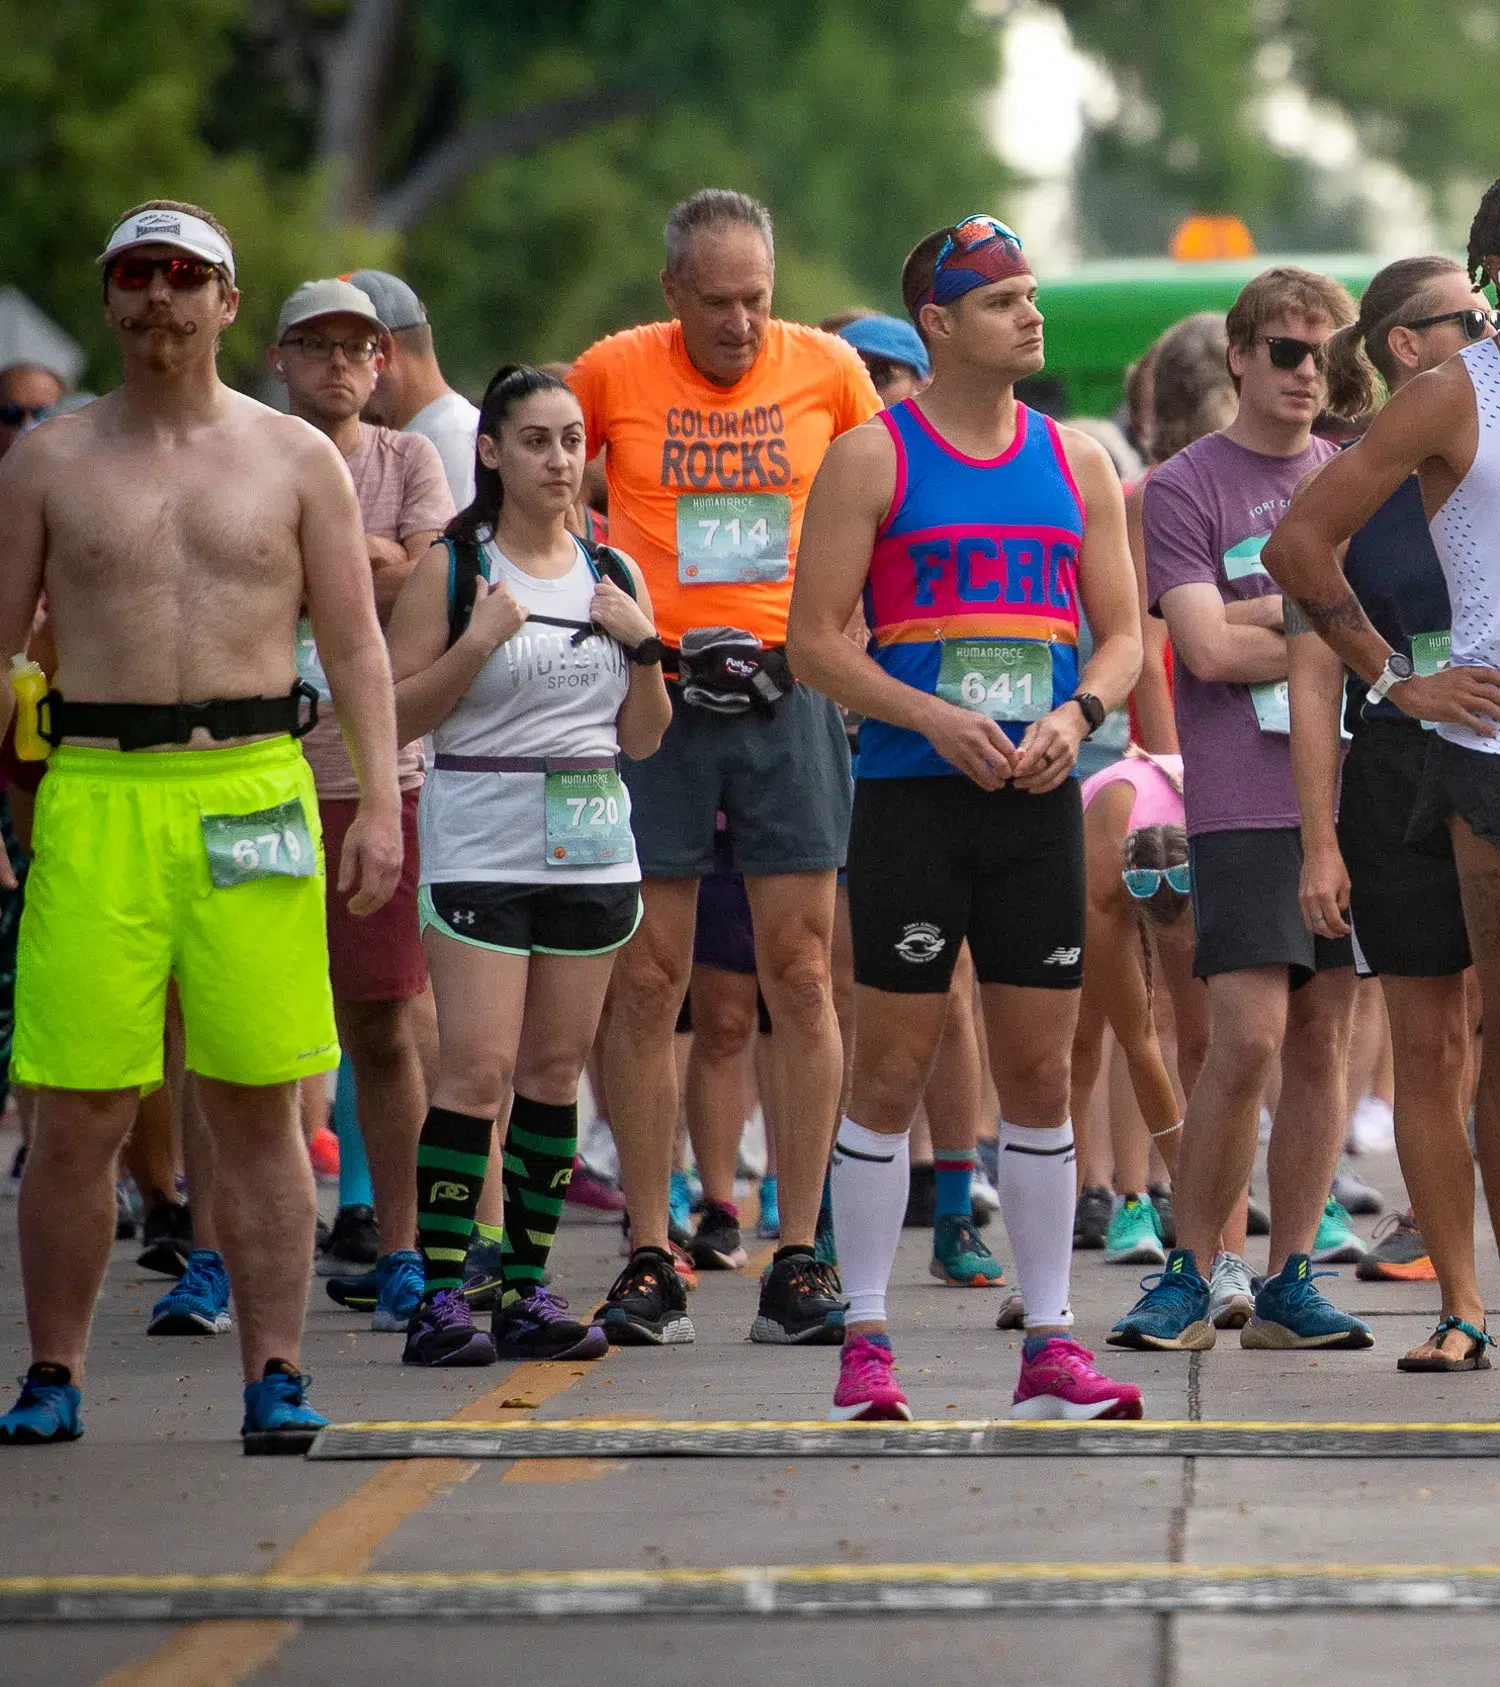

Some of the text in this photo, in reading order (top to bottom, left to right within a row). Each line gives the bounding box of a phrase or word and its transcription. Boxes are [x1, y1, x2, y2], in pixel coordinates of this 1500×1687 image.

[666, 403, 784, 439] COLORADO
[693, 497, 756, 513] HUMANRACE
[1249, 499, 1276, 519] FORT
[698, 518, 771, 547] 714
[907, 536, 1078, 610] FCRC
[955, 647, 1025, 666] HUMANRACE
[547, 672, 600, 689] SPORT
[960, 671, 1034, 705] 641
[566, 796, 619, 827] 720
[231, 829, 302, 870] 679
